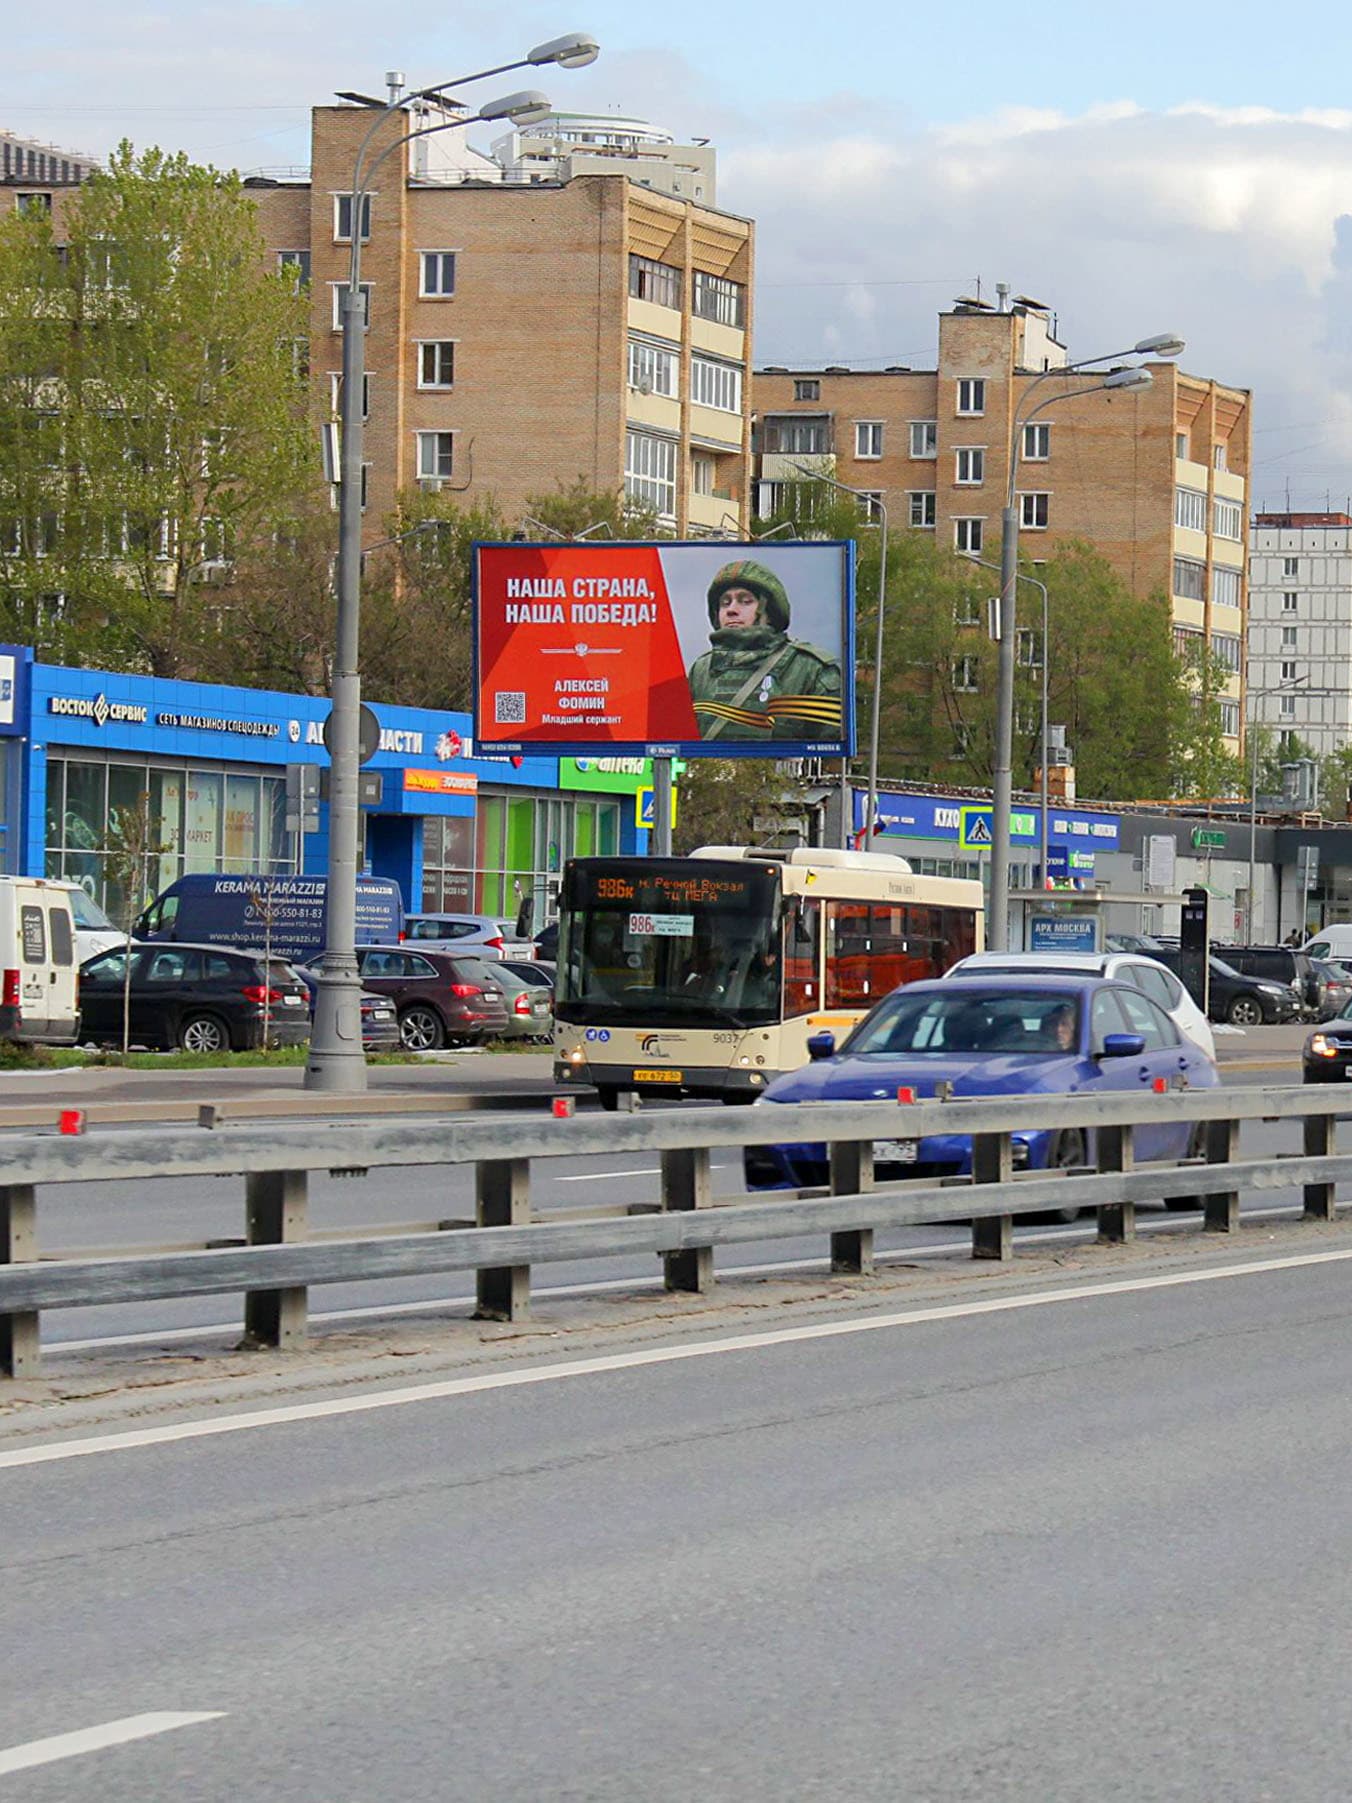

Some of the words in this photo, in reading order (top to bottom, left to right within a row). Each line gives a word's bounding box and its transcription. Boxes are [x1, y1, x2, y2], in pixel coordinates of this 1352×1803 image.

[506, 578, 567, 598] НАША
[572, 578, 656, 600] СТРАНА,
[505, 604, 565, 624] НАША
[570, 604, 657, 627] ПОБЕДА!
[554, 678, 609, 692] АЛЕКСЕЙ
[51, 698, 94, 715] ВОСТОК
[109, 706, 148, 723] СЕРВИС
[558, 697, 606, 710] ФОМИН
[158, 712, 178, 726] СЕТЬ
[179, 716, 226, 731] МАГАЗИНОВ
[227, 719, 281, 738] СПЕЦОДЕЖДЫ
[541, 714, 583, 725] Младший
[585, 715, 623, 726] сержант
[215, 881, 261, 895] KERAMA
[263, 882, 315, 895] MARAZZI
[1035, 924, 1051, 933] АРХ
[1054, 924, 1091, 933] МОСКВА
[713, 1033, 739, 1043] 9037
